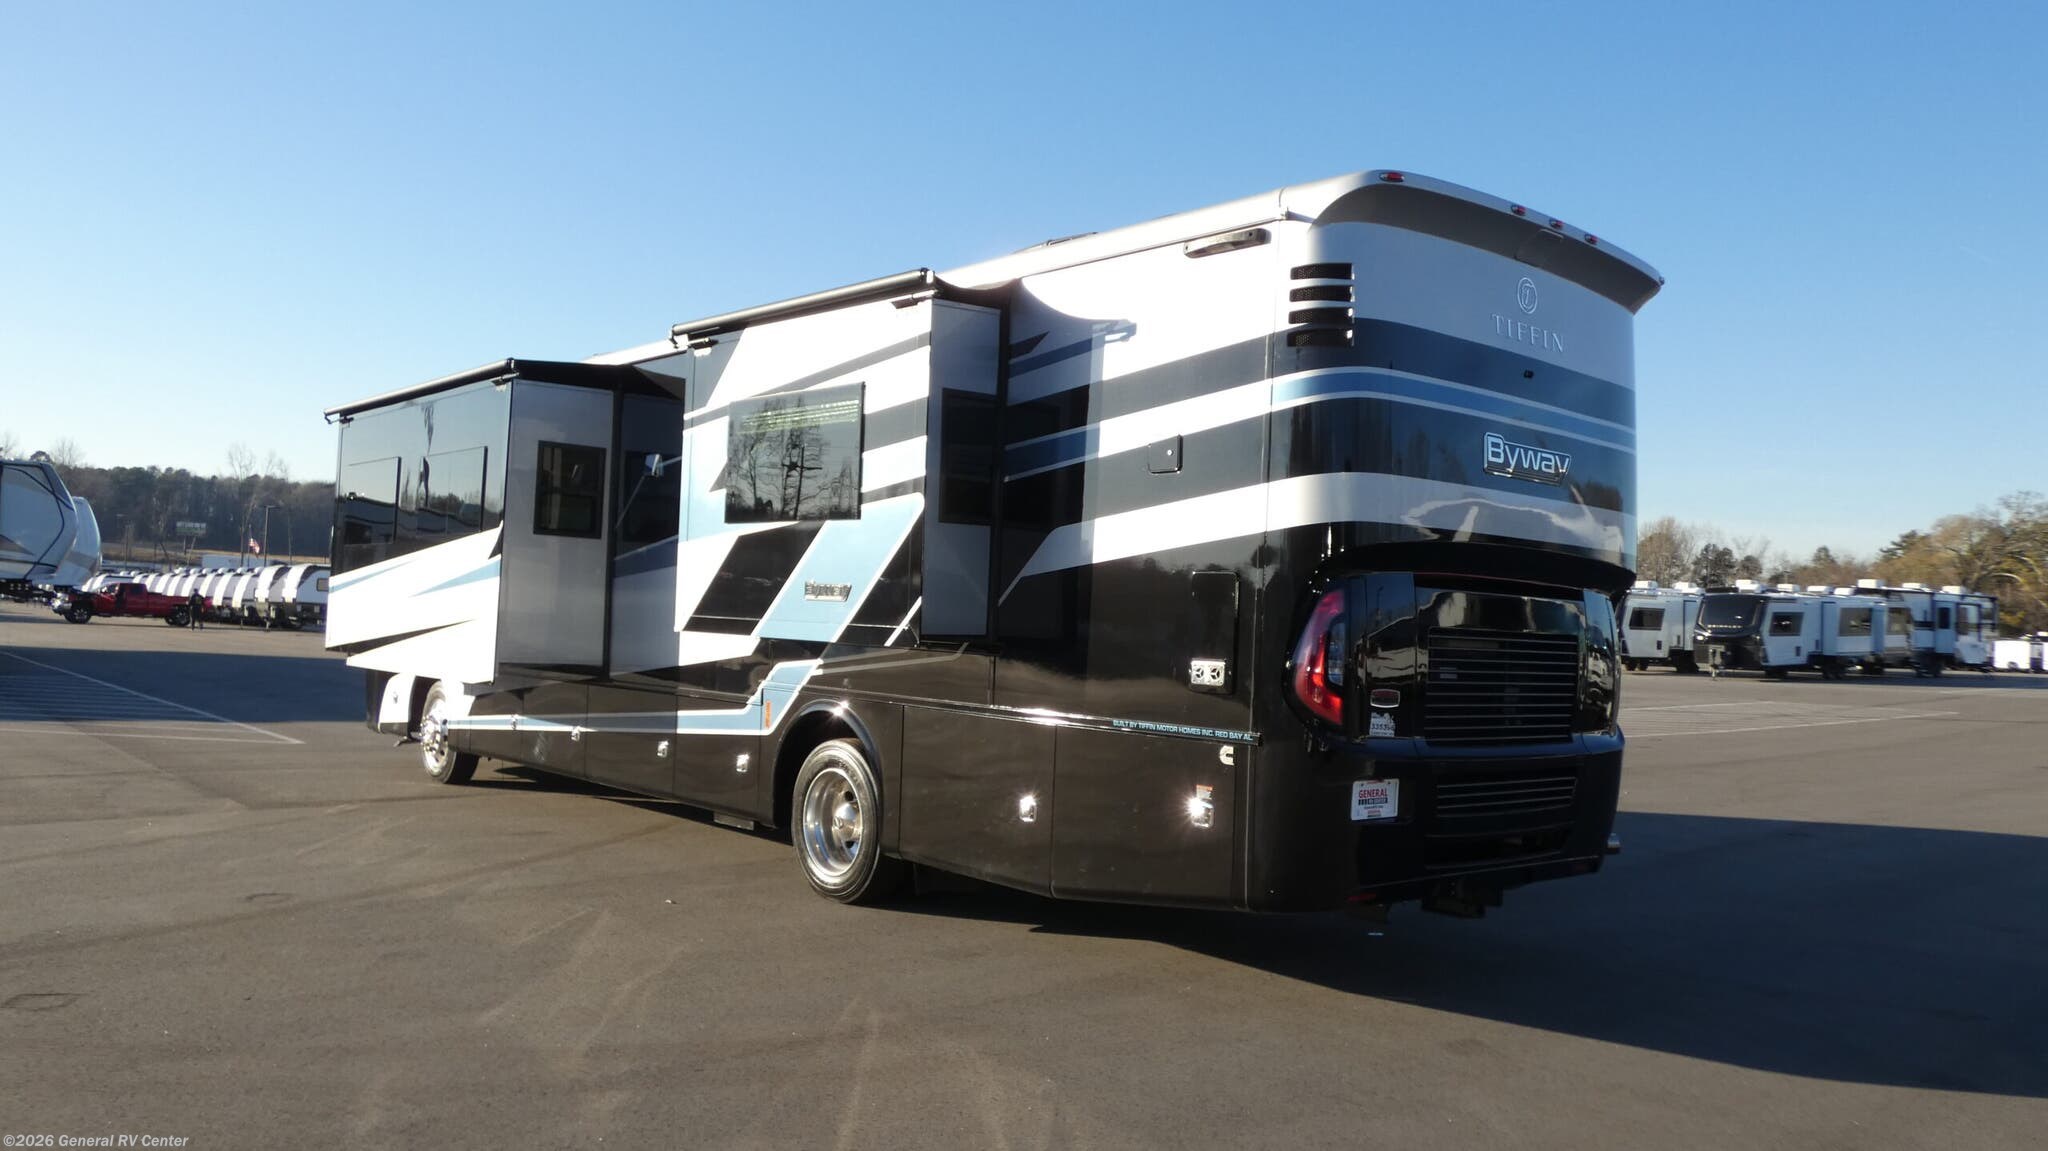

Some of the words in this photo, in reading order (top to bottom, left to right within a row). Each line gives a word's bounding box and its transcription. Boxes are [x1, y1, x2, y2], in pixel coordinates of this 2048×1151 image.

[1491, 313, 1564, 353] TIFFIN
[1487, 435, 1570, 475] Byway
[1112, 719, 1129, 728] BUILT
[1130, 721, 1137, 729] BY
[1138, 722, 1156, 730] TIFFIN
[1157, 724, 1178, 732] MOTOR
[1179, 726, 1201, 735] HOMES
[1229, 732, 1242, 740] BAY
[1358, 788, 1388, 799] GENERAL
